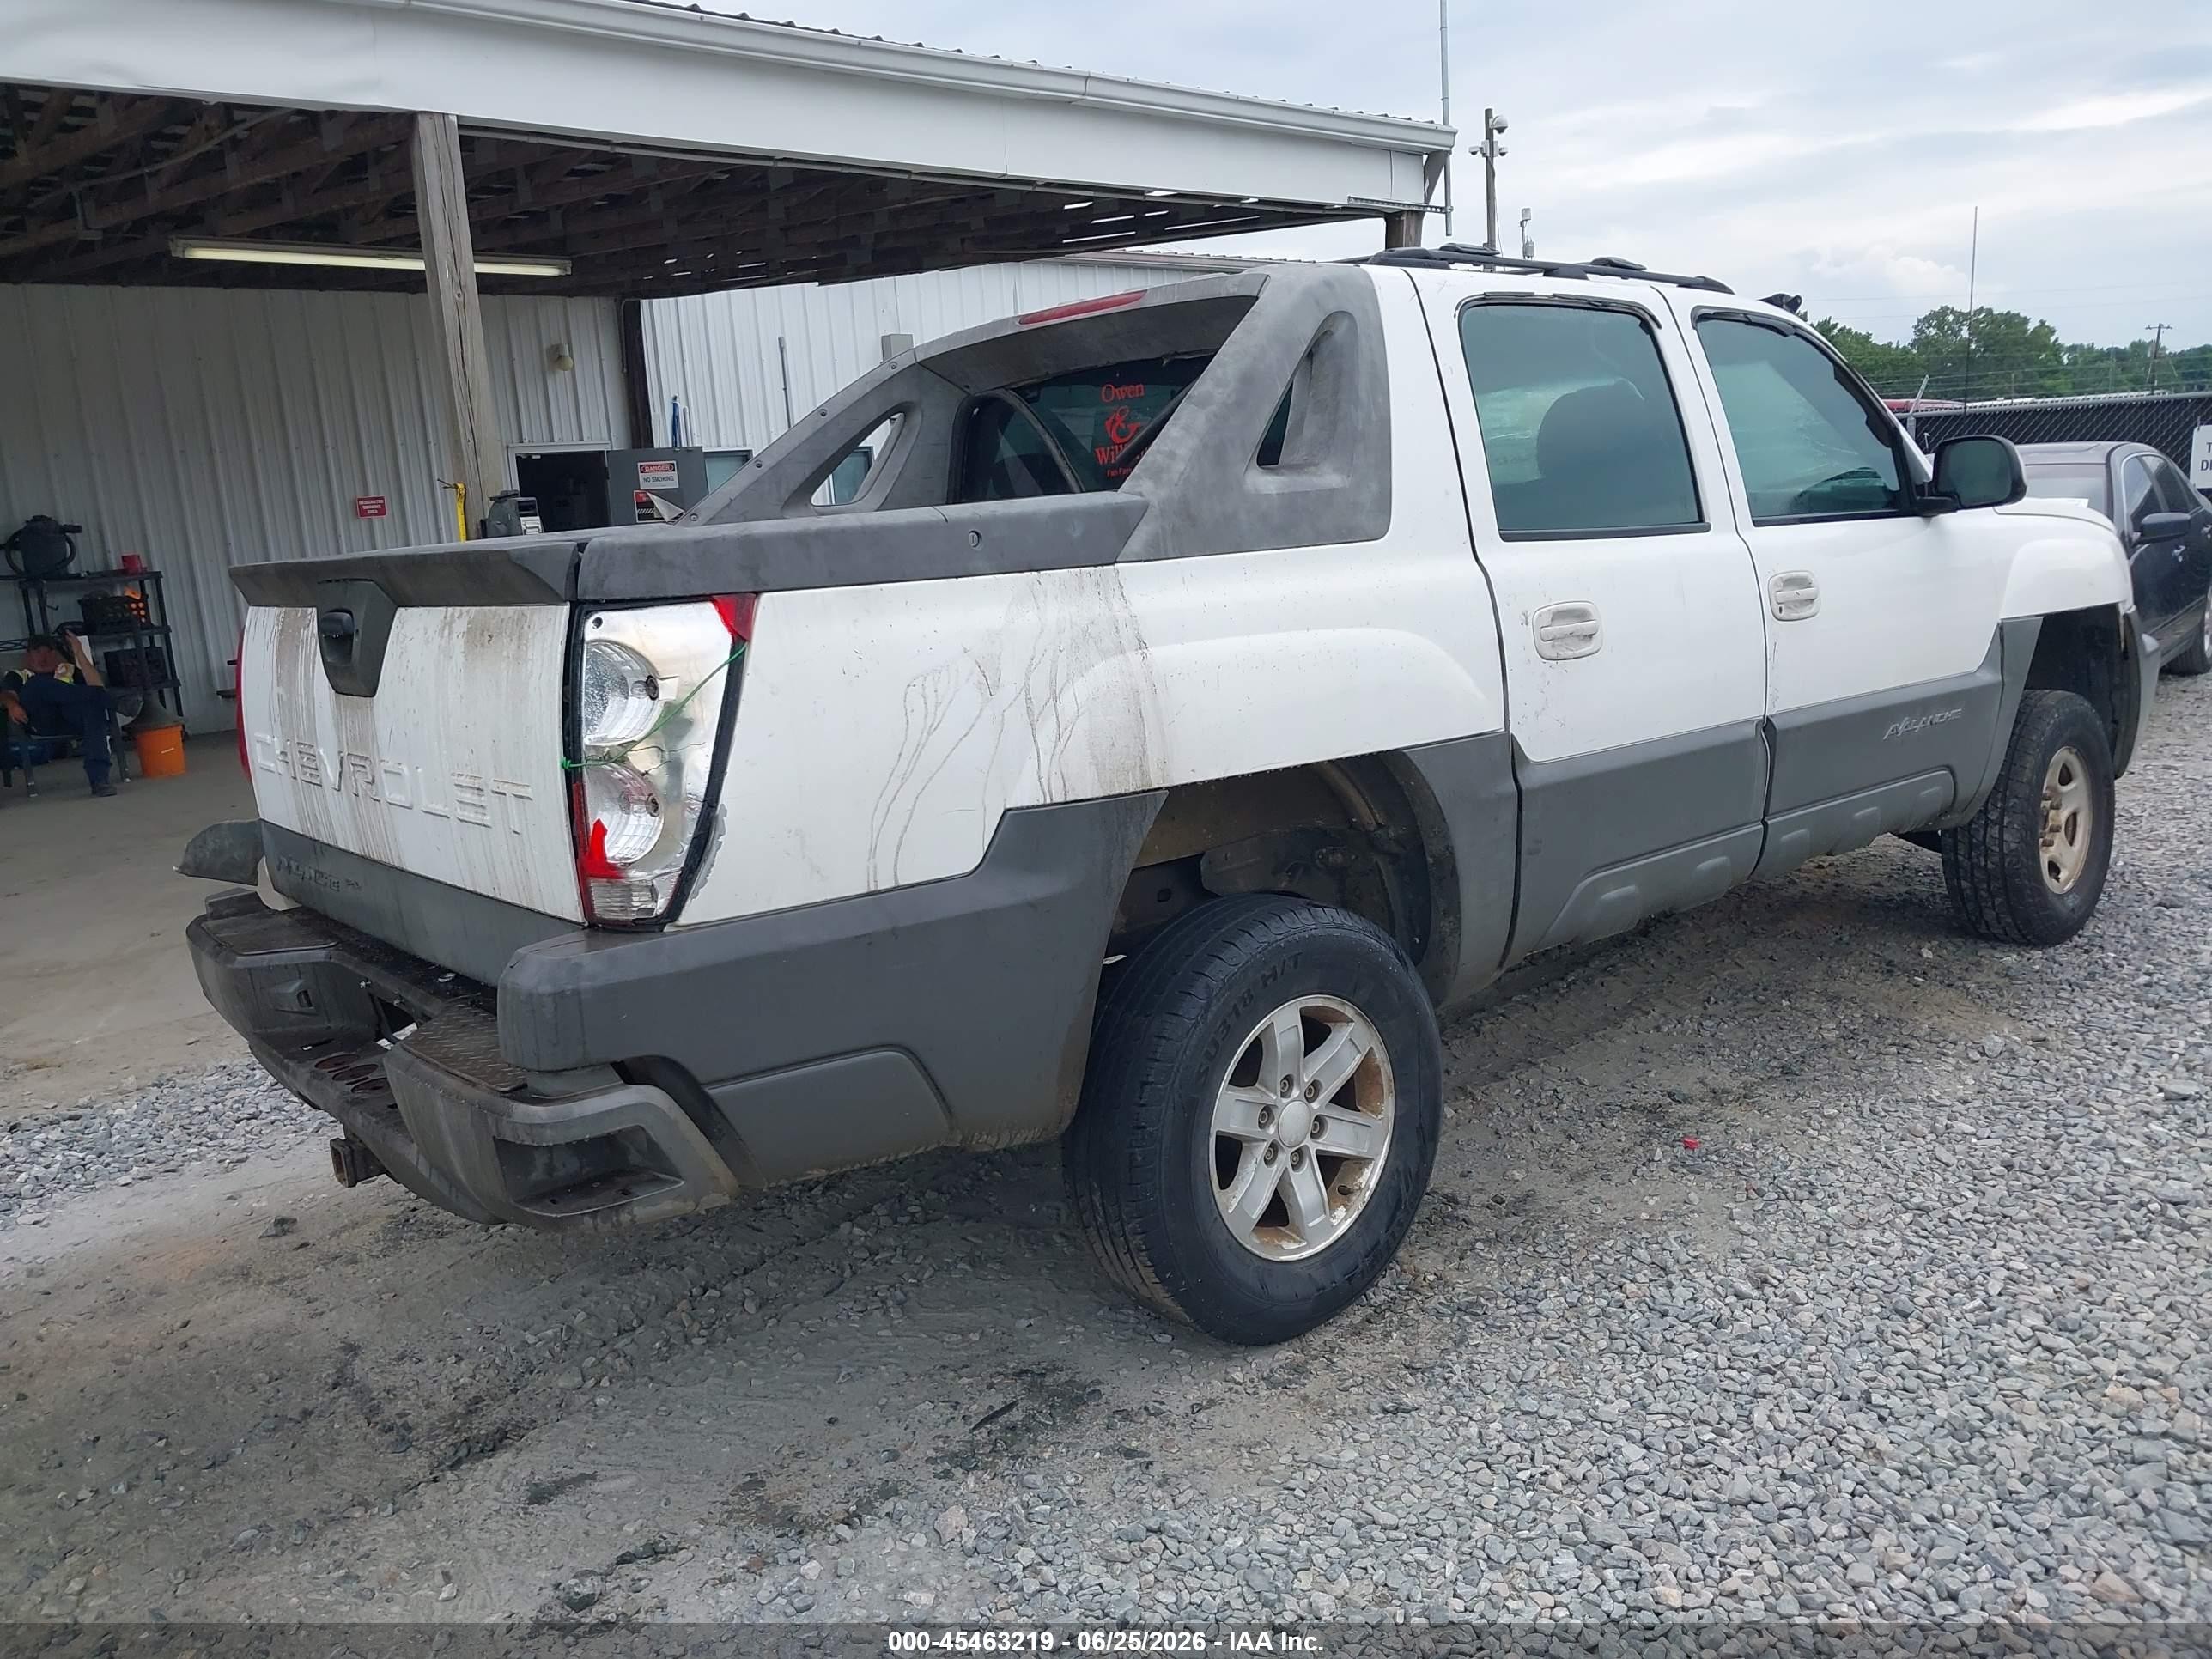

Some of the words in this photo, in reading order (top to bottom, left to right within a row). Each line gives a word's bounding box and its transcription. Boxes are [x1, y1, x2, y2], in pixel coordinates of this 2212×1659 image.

[1101, 383, 1146, 403] Owen
[1104, 405, 1142, 445] &
[254, 732, 533, 836] CHEVROLET
